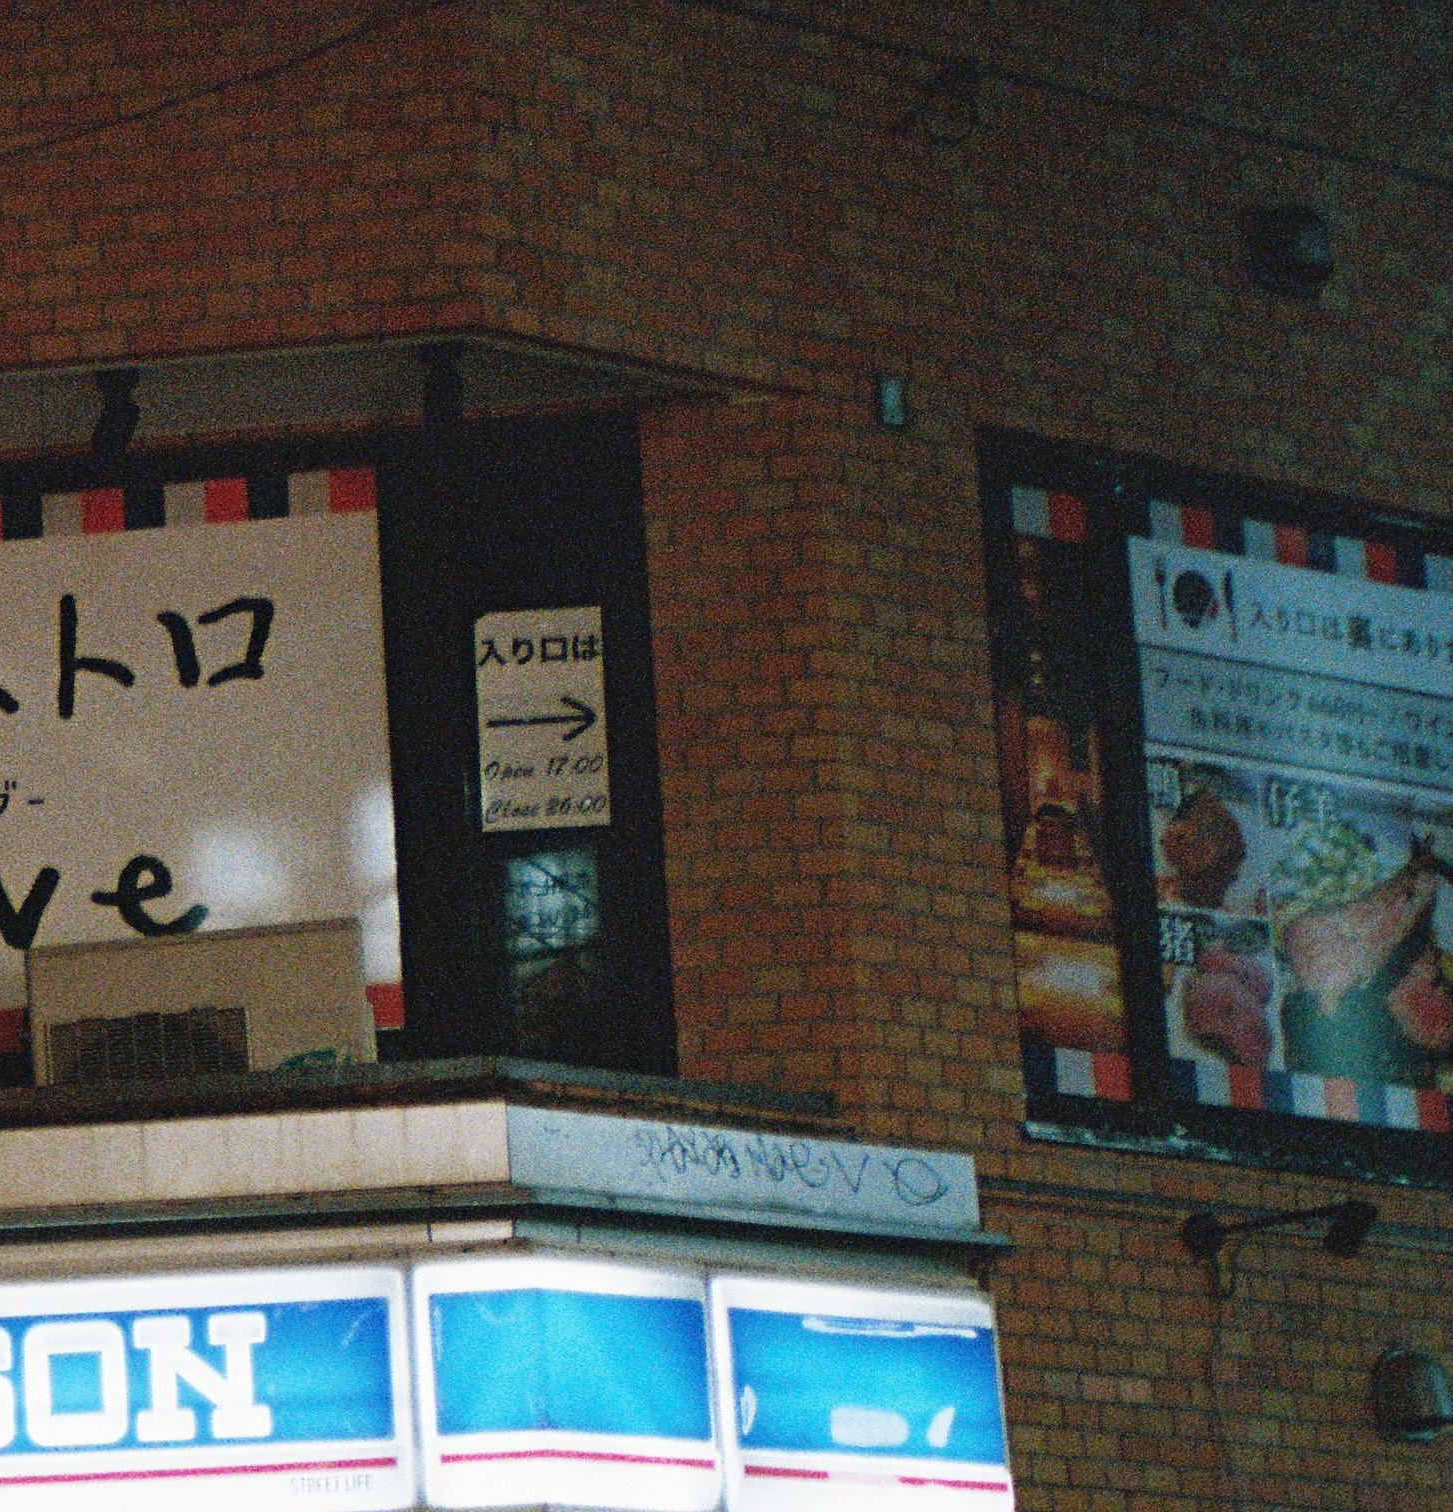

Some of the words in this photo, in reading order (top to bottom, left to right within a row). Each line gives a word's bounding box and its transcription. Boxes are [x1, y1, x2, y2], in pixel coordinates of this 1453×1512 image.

[478, 634, 600, 667] 入り口は
[484, 760, 535, 782] Open
[484, 800, 539, 823] Close
